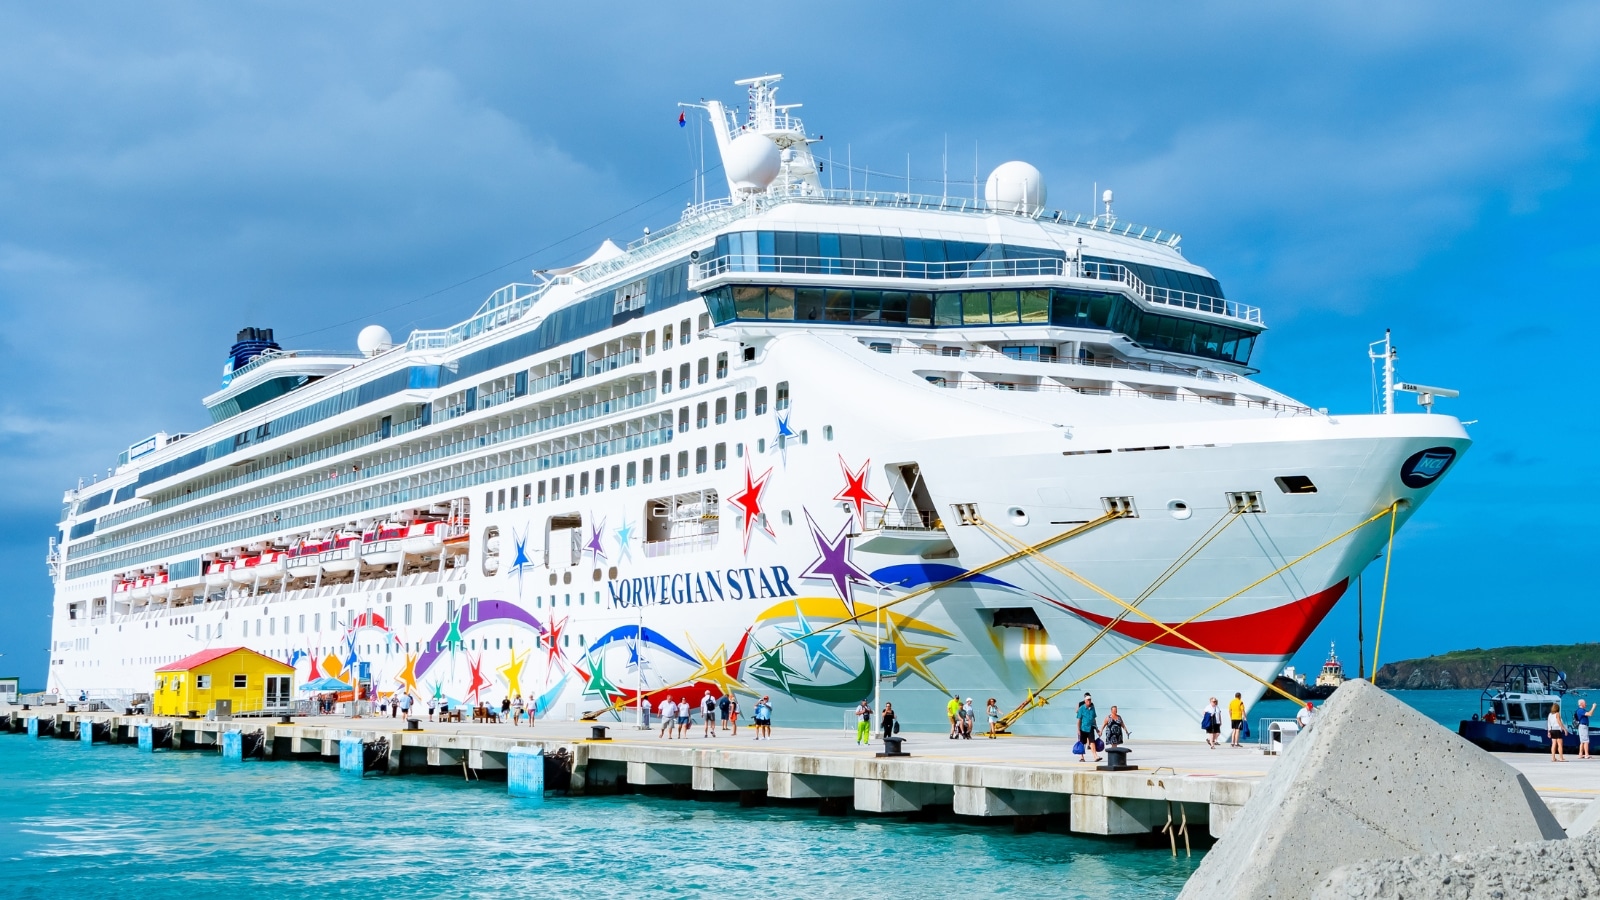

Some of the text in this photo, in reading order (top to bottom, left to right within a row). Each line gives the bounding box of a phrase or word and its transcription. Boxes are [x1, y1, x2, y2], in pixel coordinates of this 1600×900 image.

[1420, 459, 1443, 469] NCL
[607, 565, 799, 610] NORWEGIAN STAR
